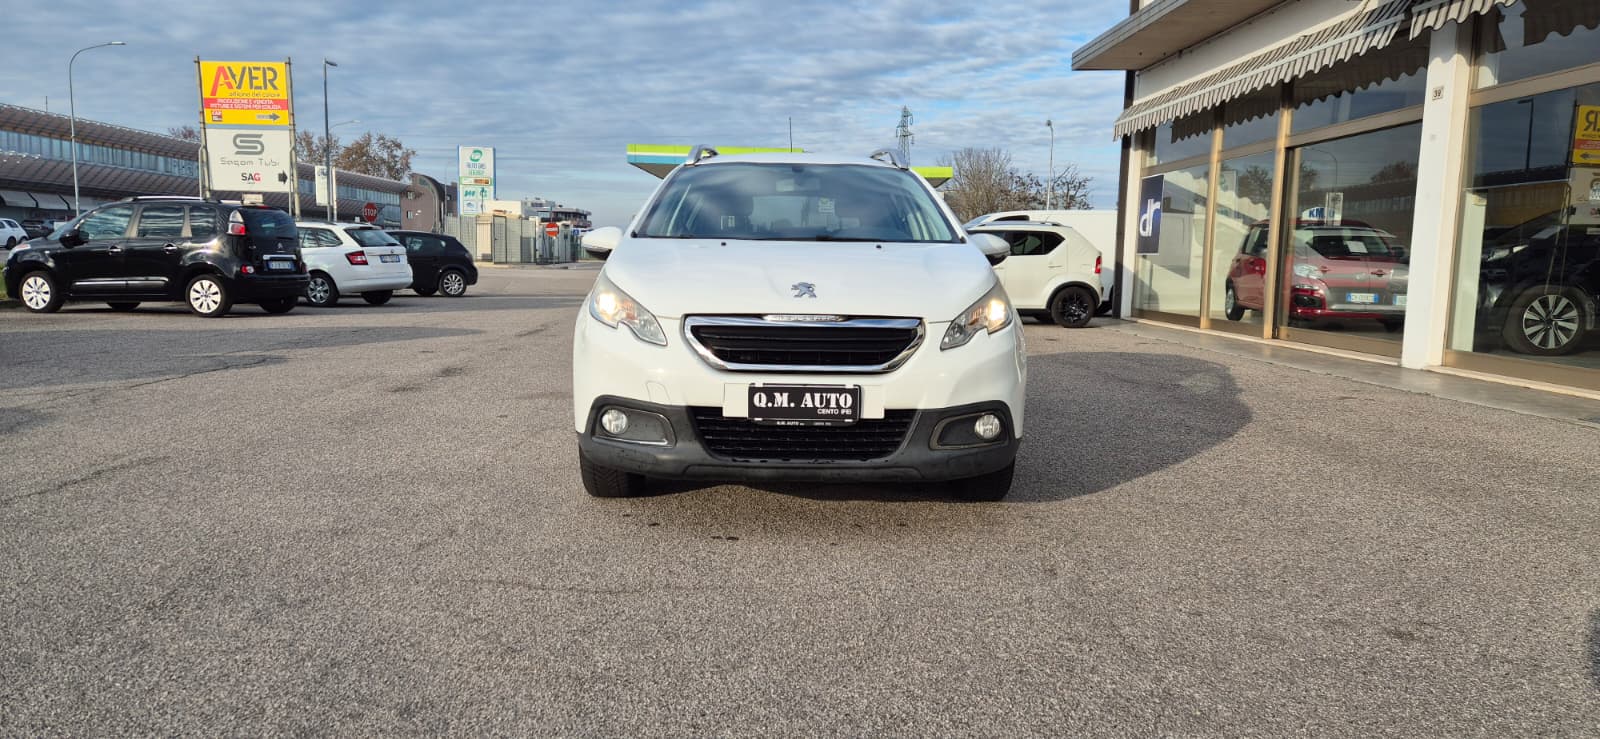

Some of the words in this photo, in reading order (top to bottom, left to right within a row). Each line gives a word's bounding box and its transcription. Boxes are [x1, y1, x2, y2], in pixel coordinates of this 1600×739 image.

[210, 66, 278, 96] AVER
[241, 172, 261, 182] SAG
[364, 208, 377, 217] STOP
[753, 392, 795, 408] Q.M.
[800, 392, 853, 409] AUTO
